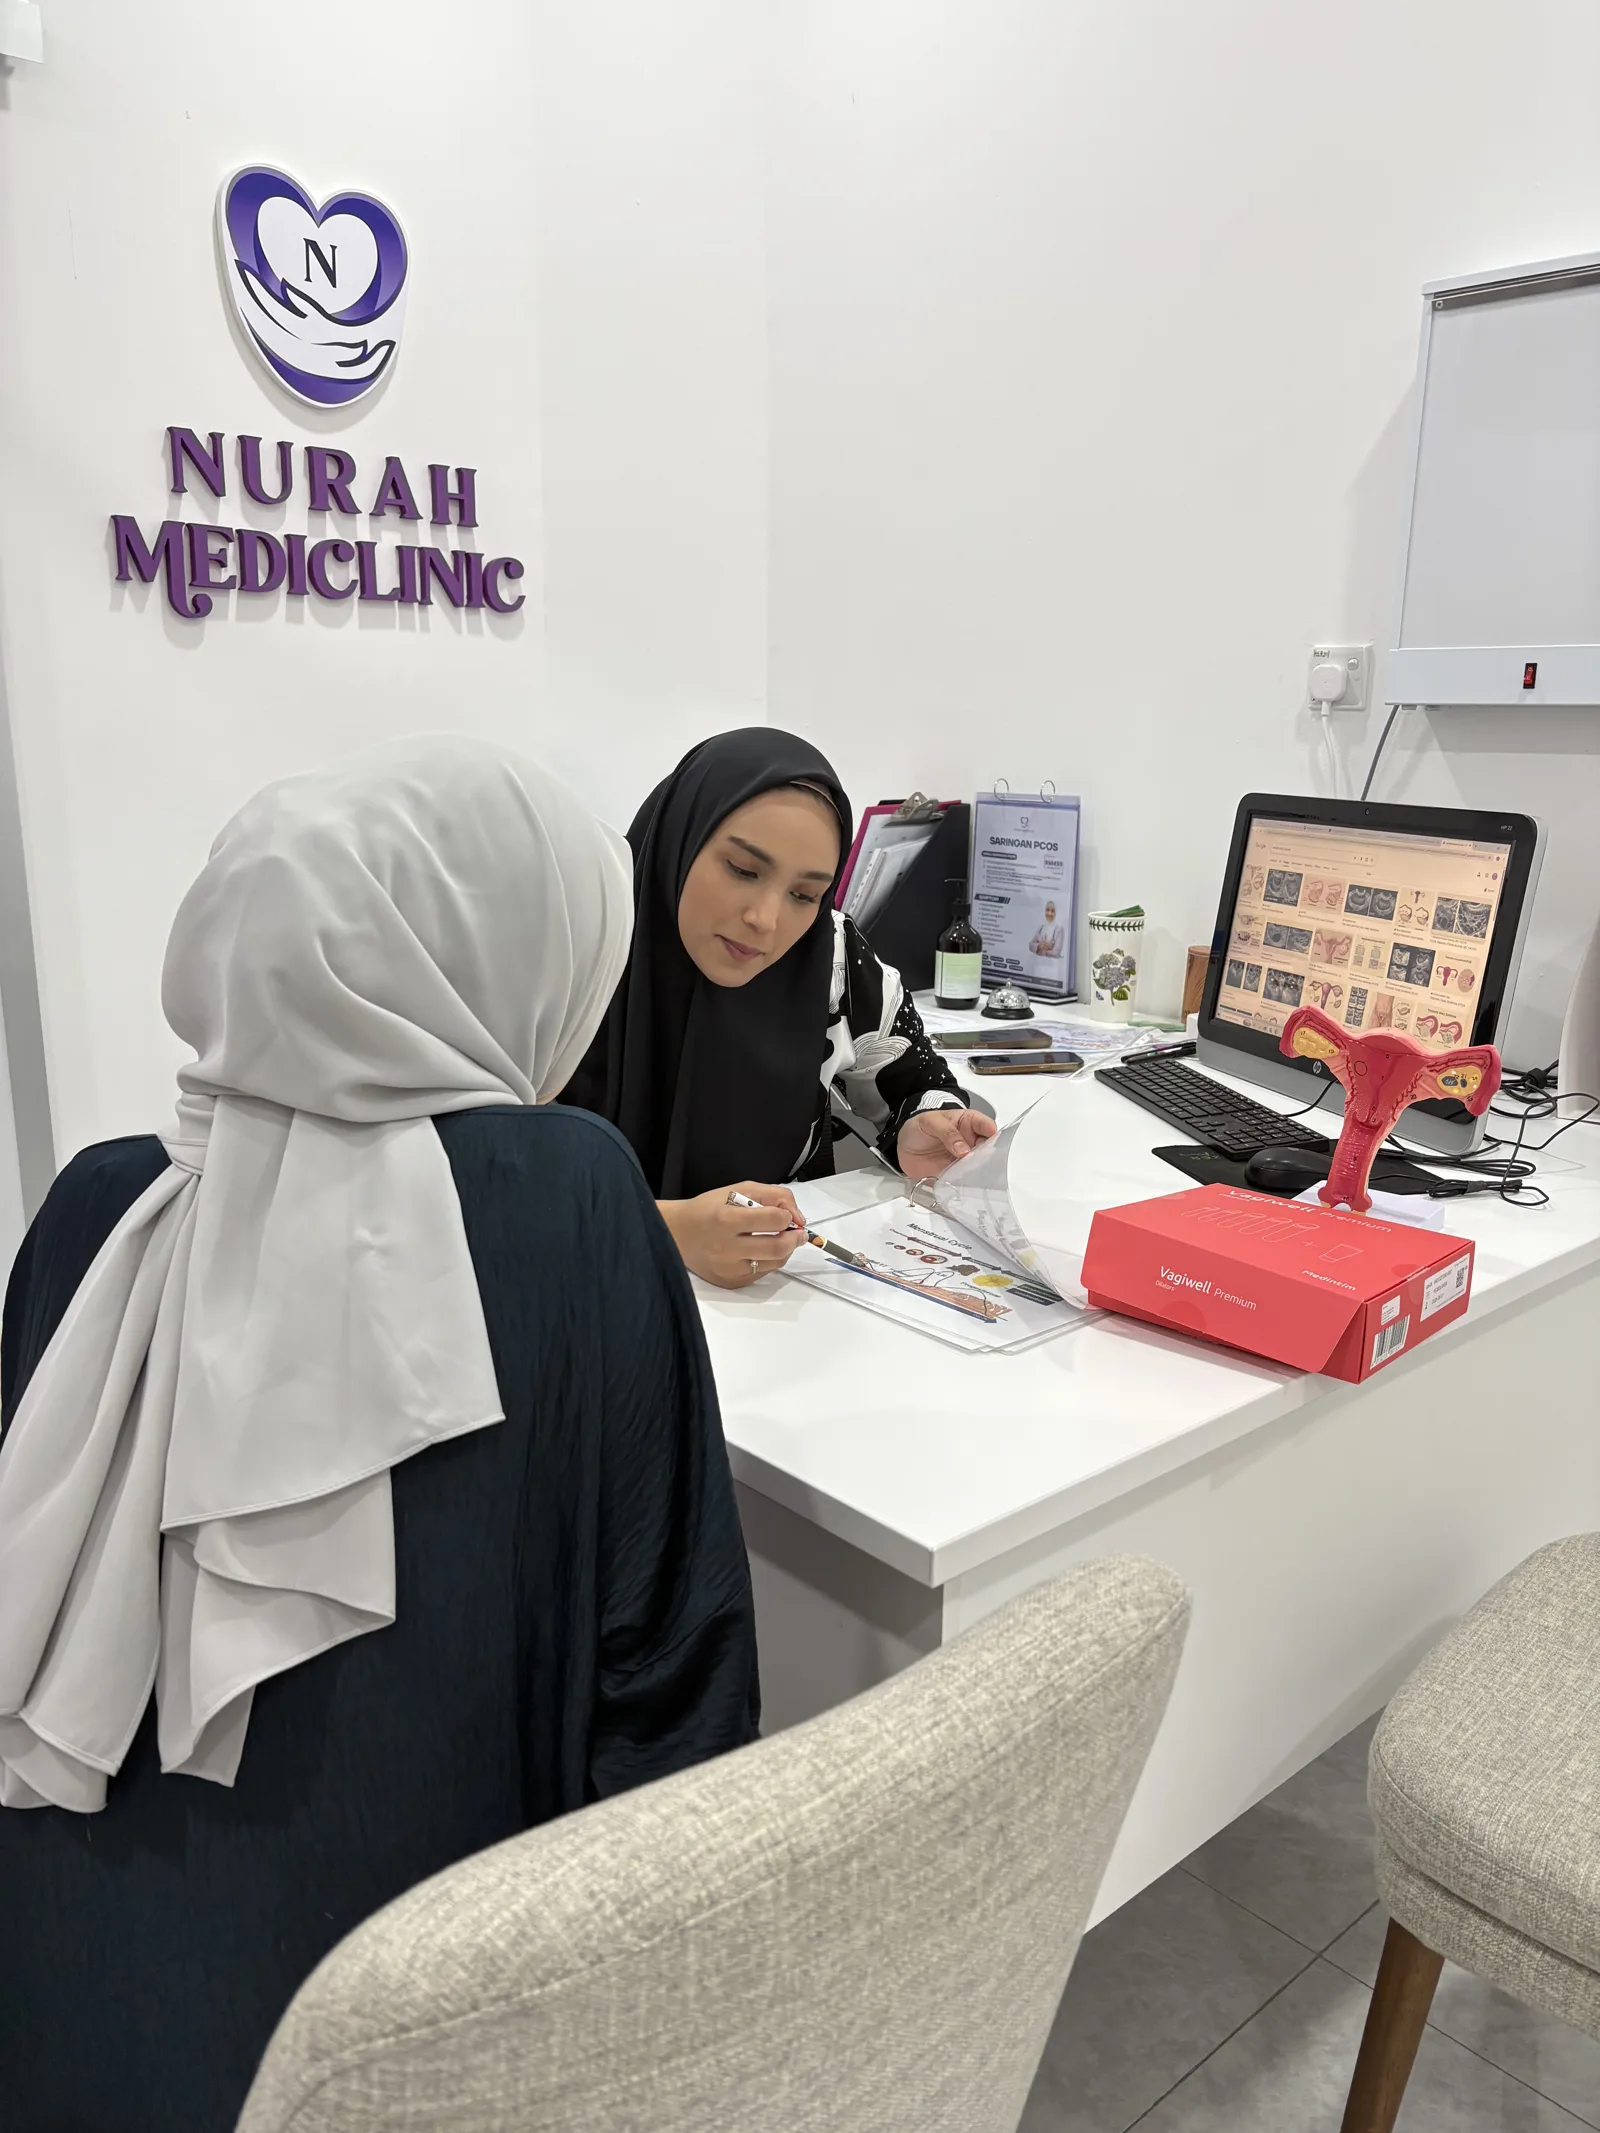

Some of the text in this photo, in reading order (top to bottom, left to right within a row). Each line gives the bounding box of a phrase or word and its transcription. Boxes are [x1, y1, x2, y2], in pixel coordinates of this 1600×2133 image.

[304, 238, 338, 288] N
[166, 425, 479, 528] NURAH
[111, 514, 526, 618] MEDICLINIC
[989, 836, 1059, 852] SARINGAN PCOS
[1230, 1190, 1315, 1213] Vagiwell
[1319, 1212, 1392, 1233] Premium
[907, 1222, 948, 1241] Menstrual
[948, 1239, 973, 1250] Cycle
[1155, 1279, 1175, 1292] Dilators
[1160, 1265, 1257, 1311] Vagiwell Premium
[1301, 1269, 1357, 1291] Medintim
